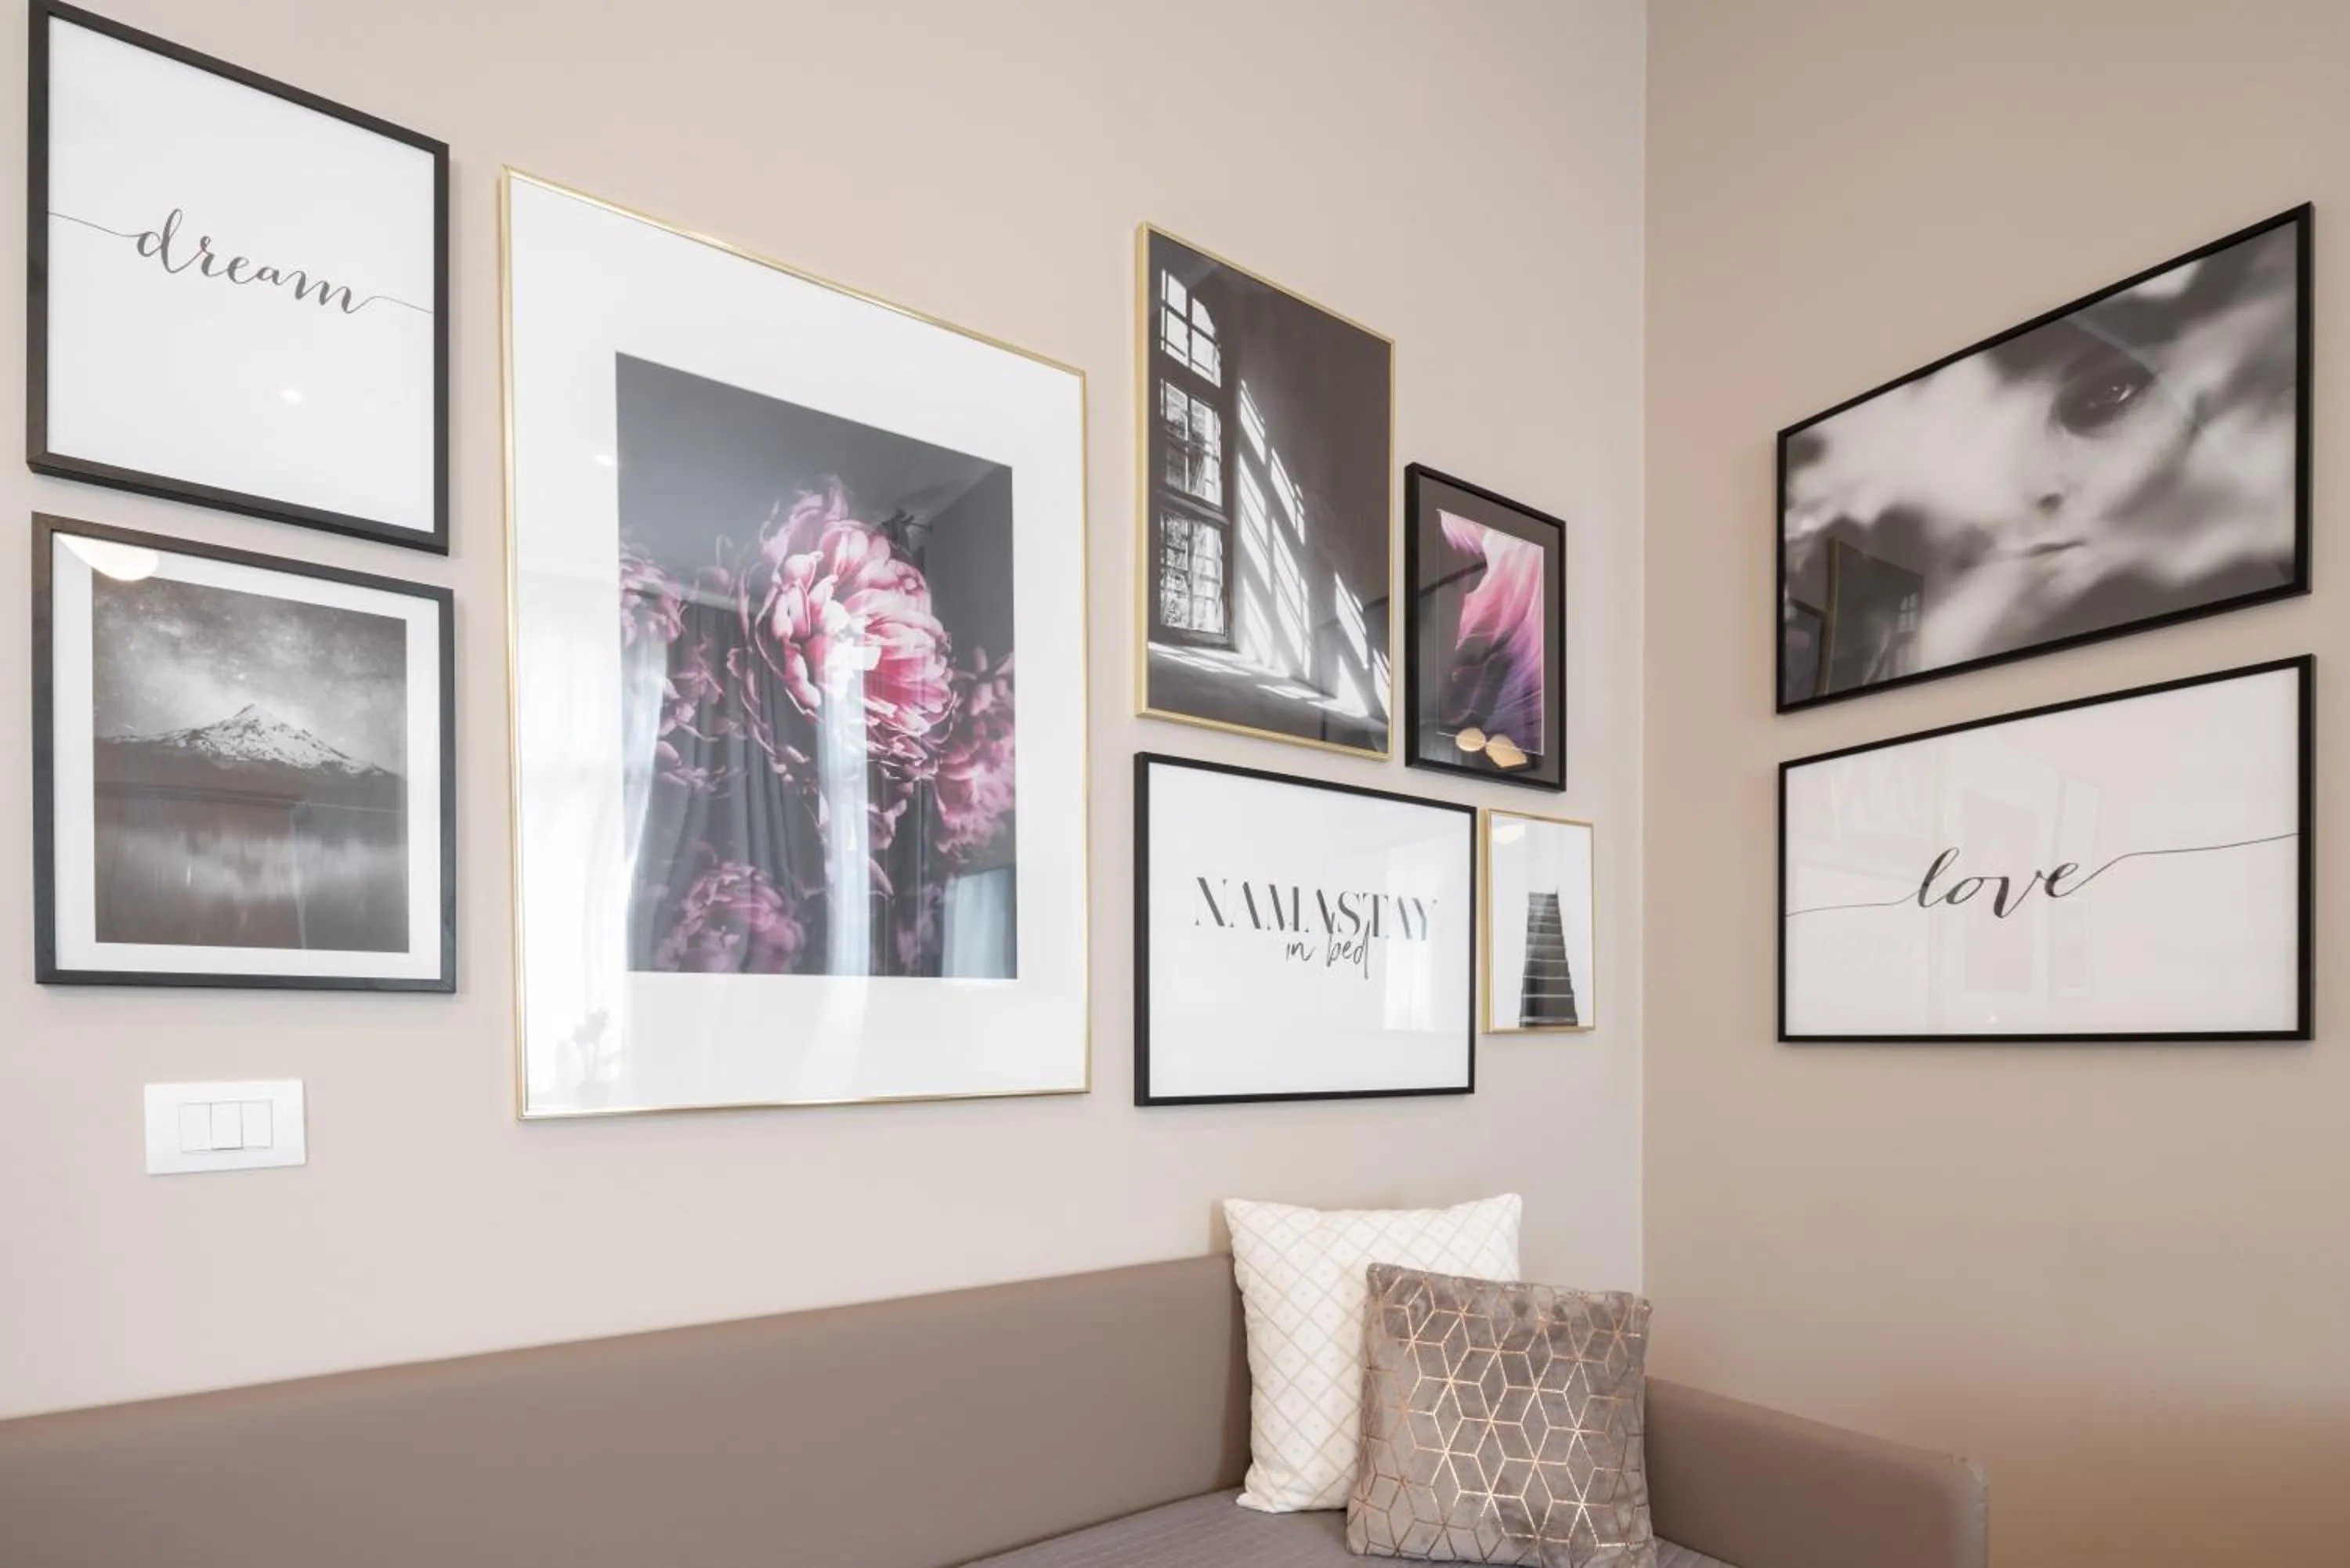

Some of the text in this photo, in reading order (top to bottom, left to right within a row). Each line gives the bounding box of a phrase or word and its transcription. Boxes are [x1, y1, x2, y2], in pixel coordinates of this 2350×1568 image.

[135, 208, 370, 315] dream
[1194, 876, 1438, 941] NAMASTAY
[1916, 847, 2087, 919] love
[1285, 912, 1371, 980] in bed
